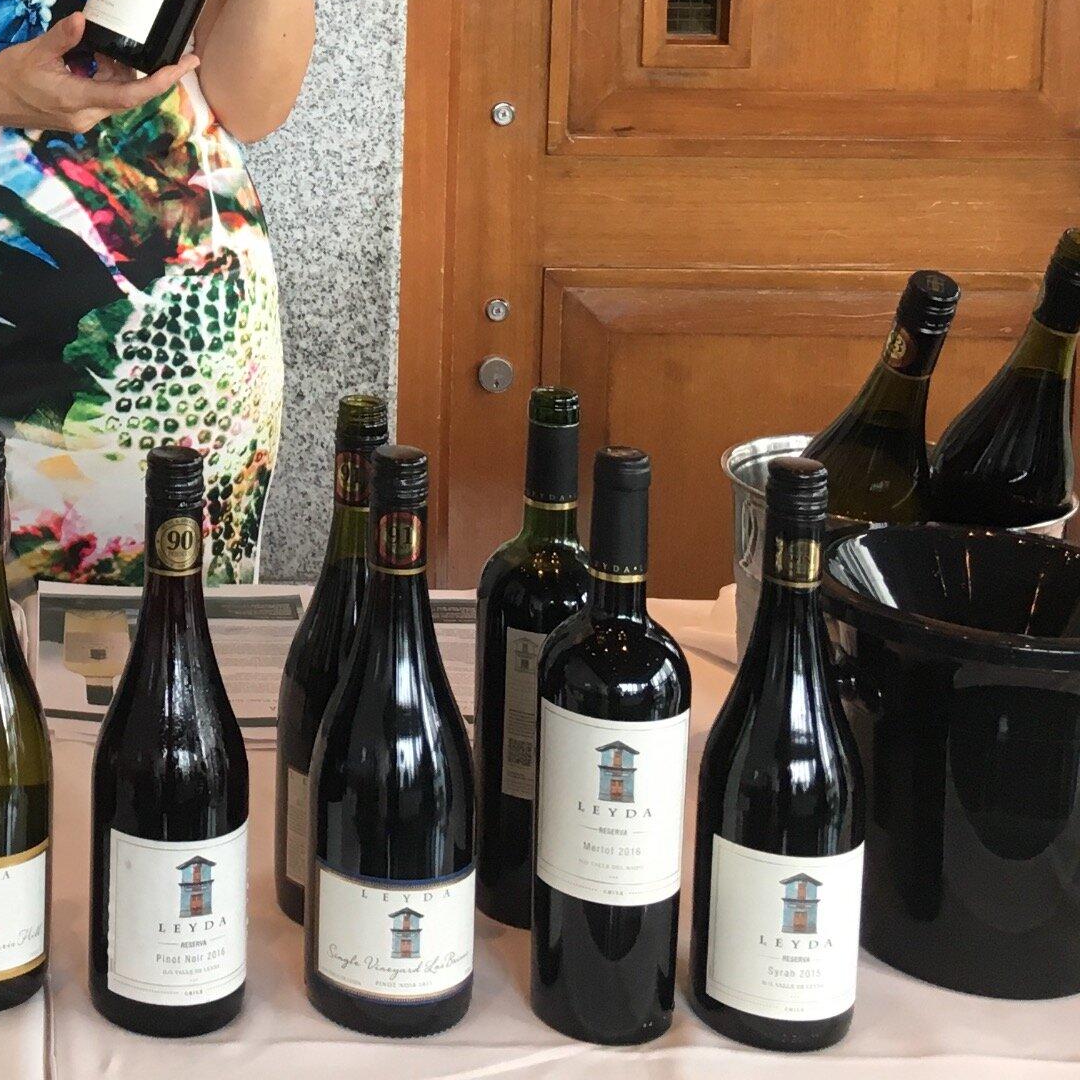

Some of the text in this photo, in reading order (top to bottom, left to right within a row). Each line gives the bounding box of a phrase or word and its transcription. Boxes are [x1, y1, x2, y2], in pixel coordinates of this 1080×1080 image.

[166, 530, 193, 551] 90
[577, 800, 653, 819] LEYDA
[598, 826, 628, 836] RESERVA
[582, 841, 615, 856] Merlot
[360, 888, 452, 904] LEYDA
[158, 916, 227, 933] LEYDA
[180, 939, 208, 949] RESERVA
[759, 934, 834, 950] LEYDA
[156, 953, 181, 964] Pinot
[184, 953, 204, 964] Noir
[326, 942, 361, 969] Single
[363, 954, 423, 981] Vineyard
[767, 965, 823, 979] Syrah 2015
